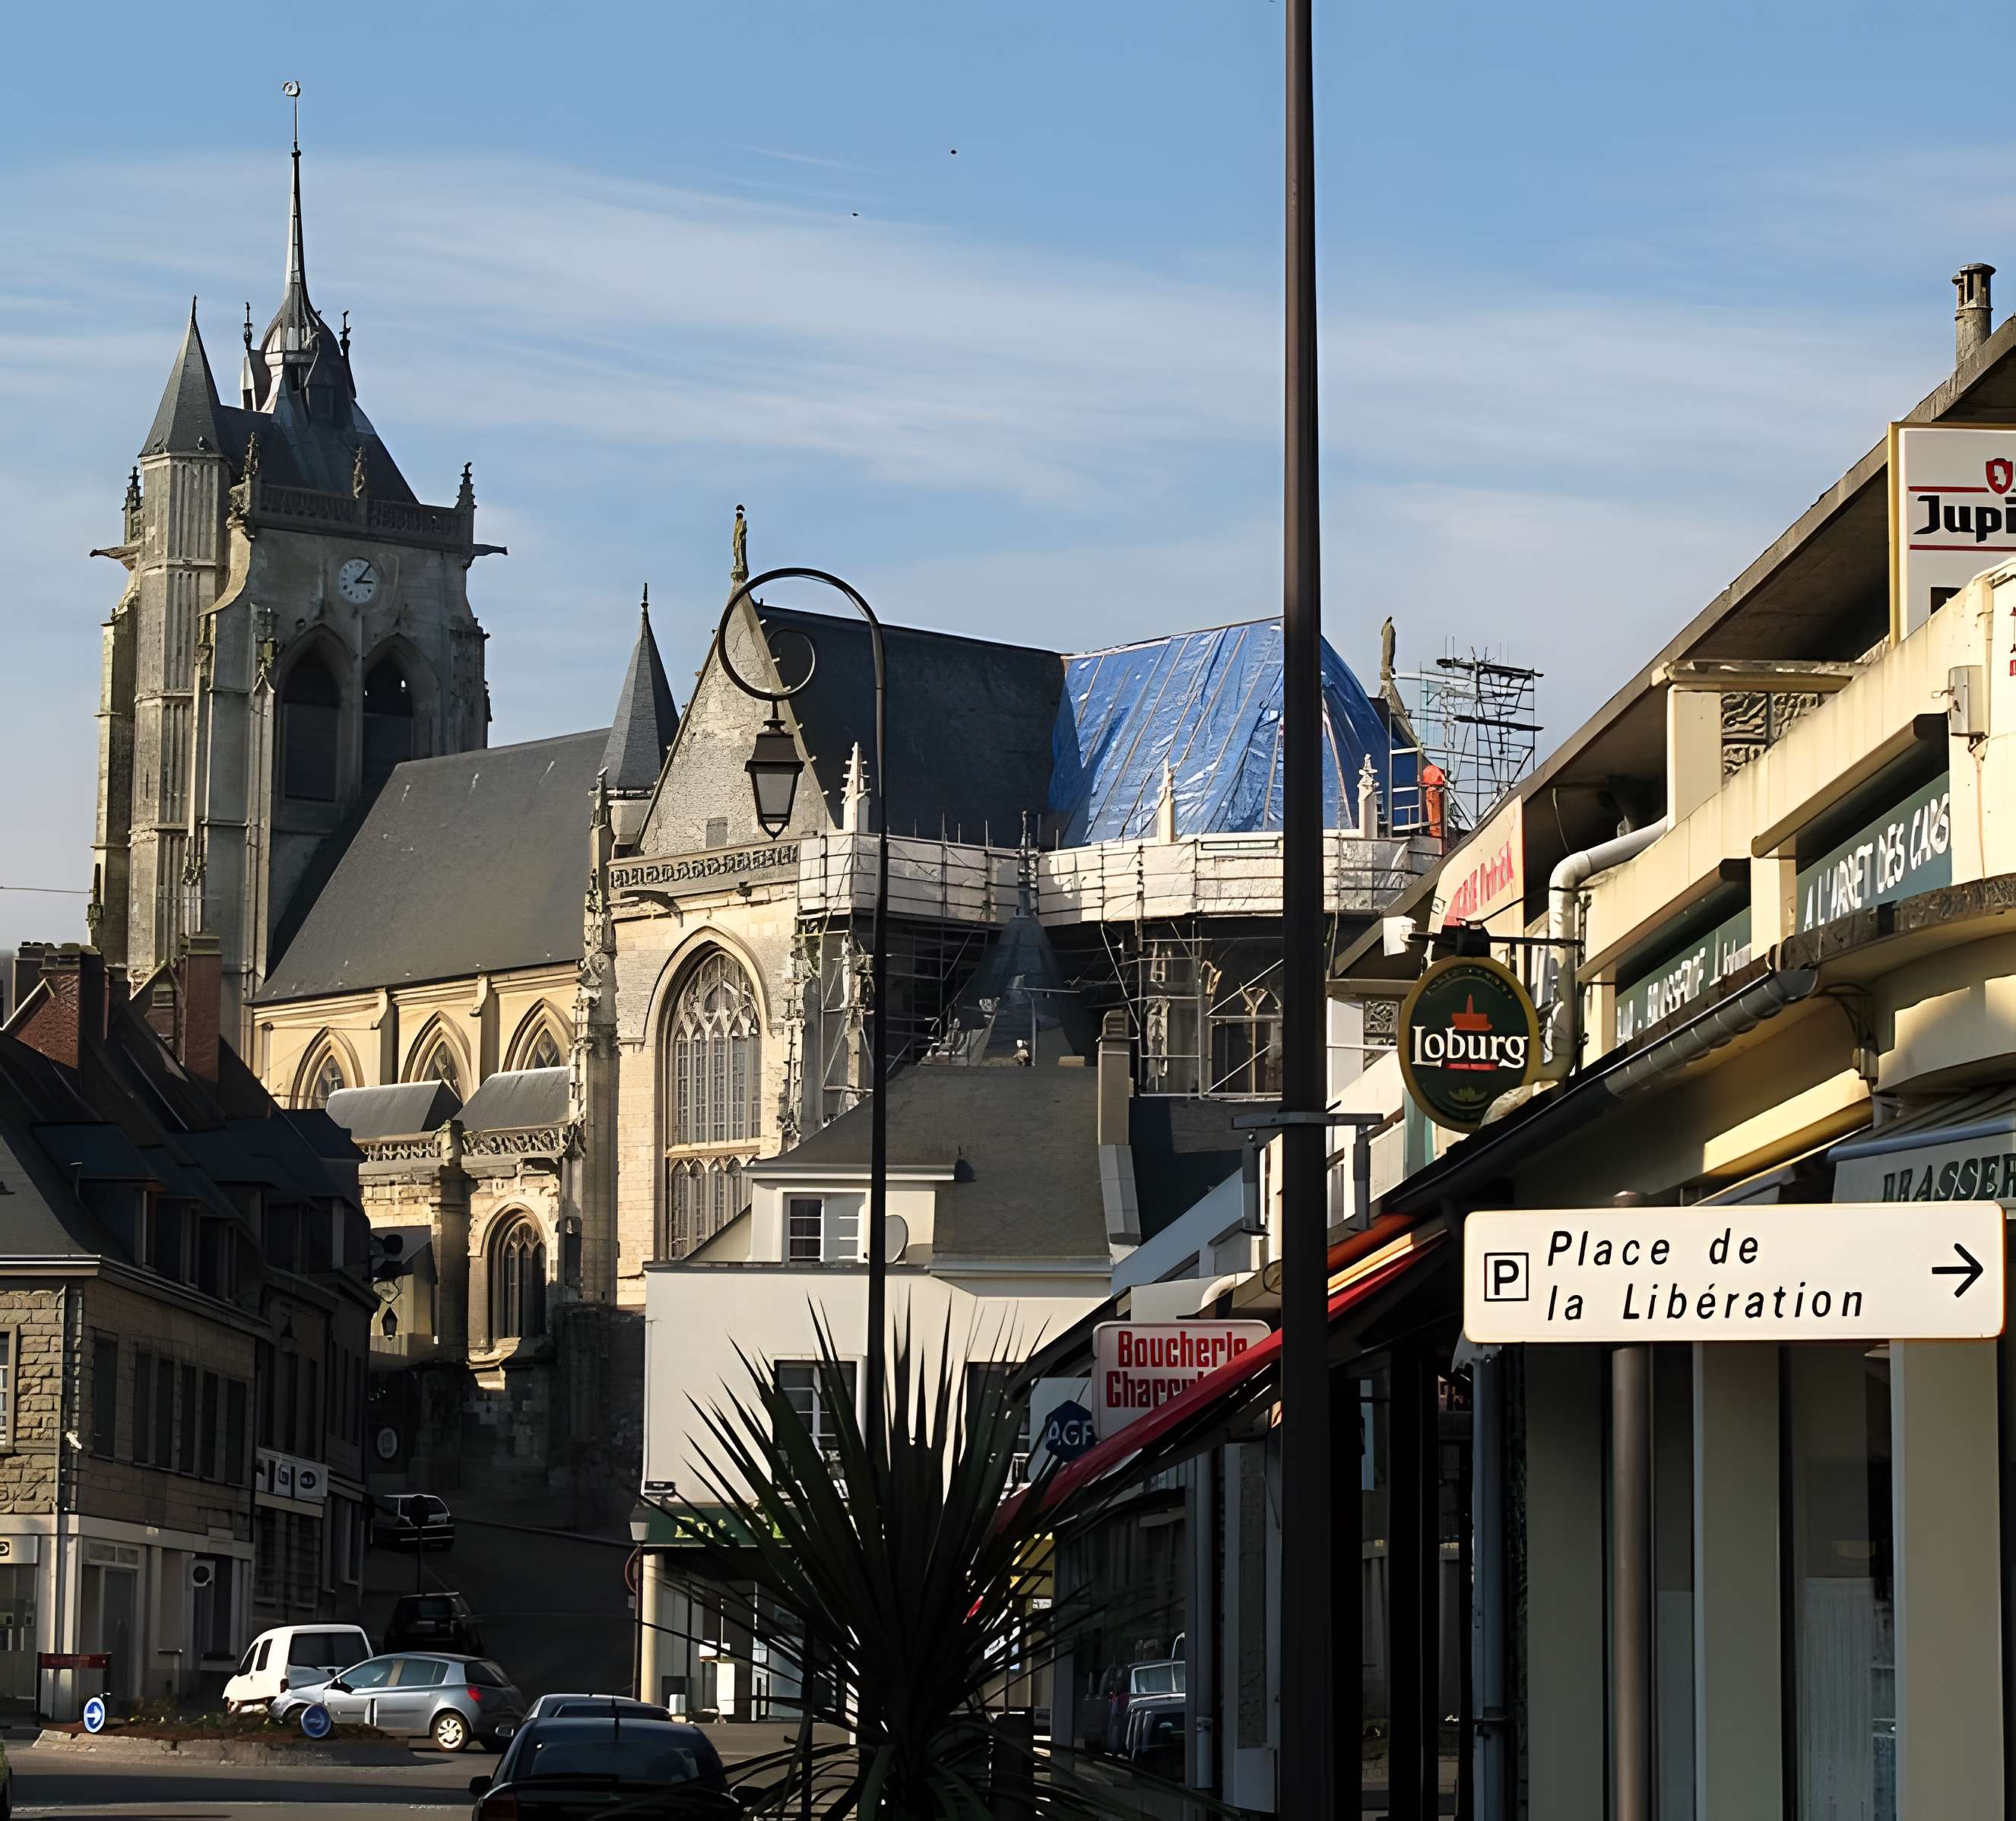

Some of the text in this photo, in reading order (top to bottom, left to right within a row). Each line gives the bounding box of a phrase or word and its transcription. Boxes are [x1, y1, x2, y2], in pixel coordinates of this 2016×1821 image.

[1913, 495, 2016, 543] Jupi
[1412, 1027, 1528, 1068] Loburg
[1548, 1228, 1758, 1266] Place de
[1548, 1282, 1862, 1320] la Libération
